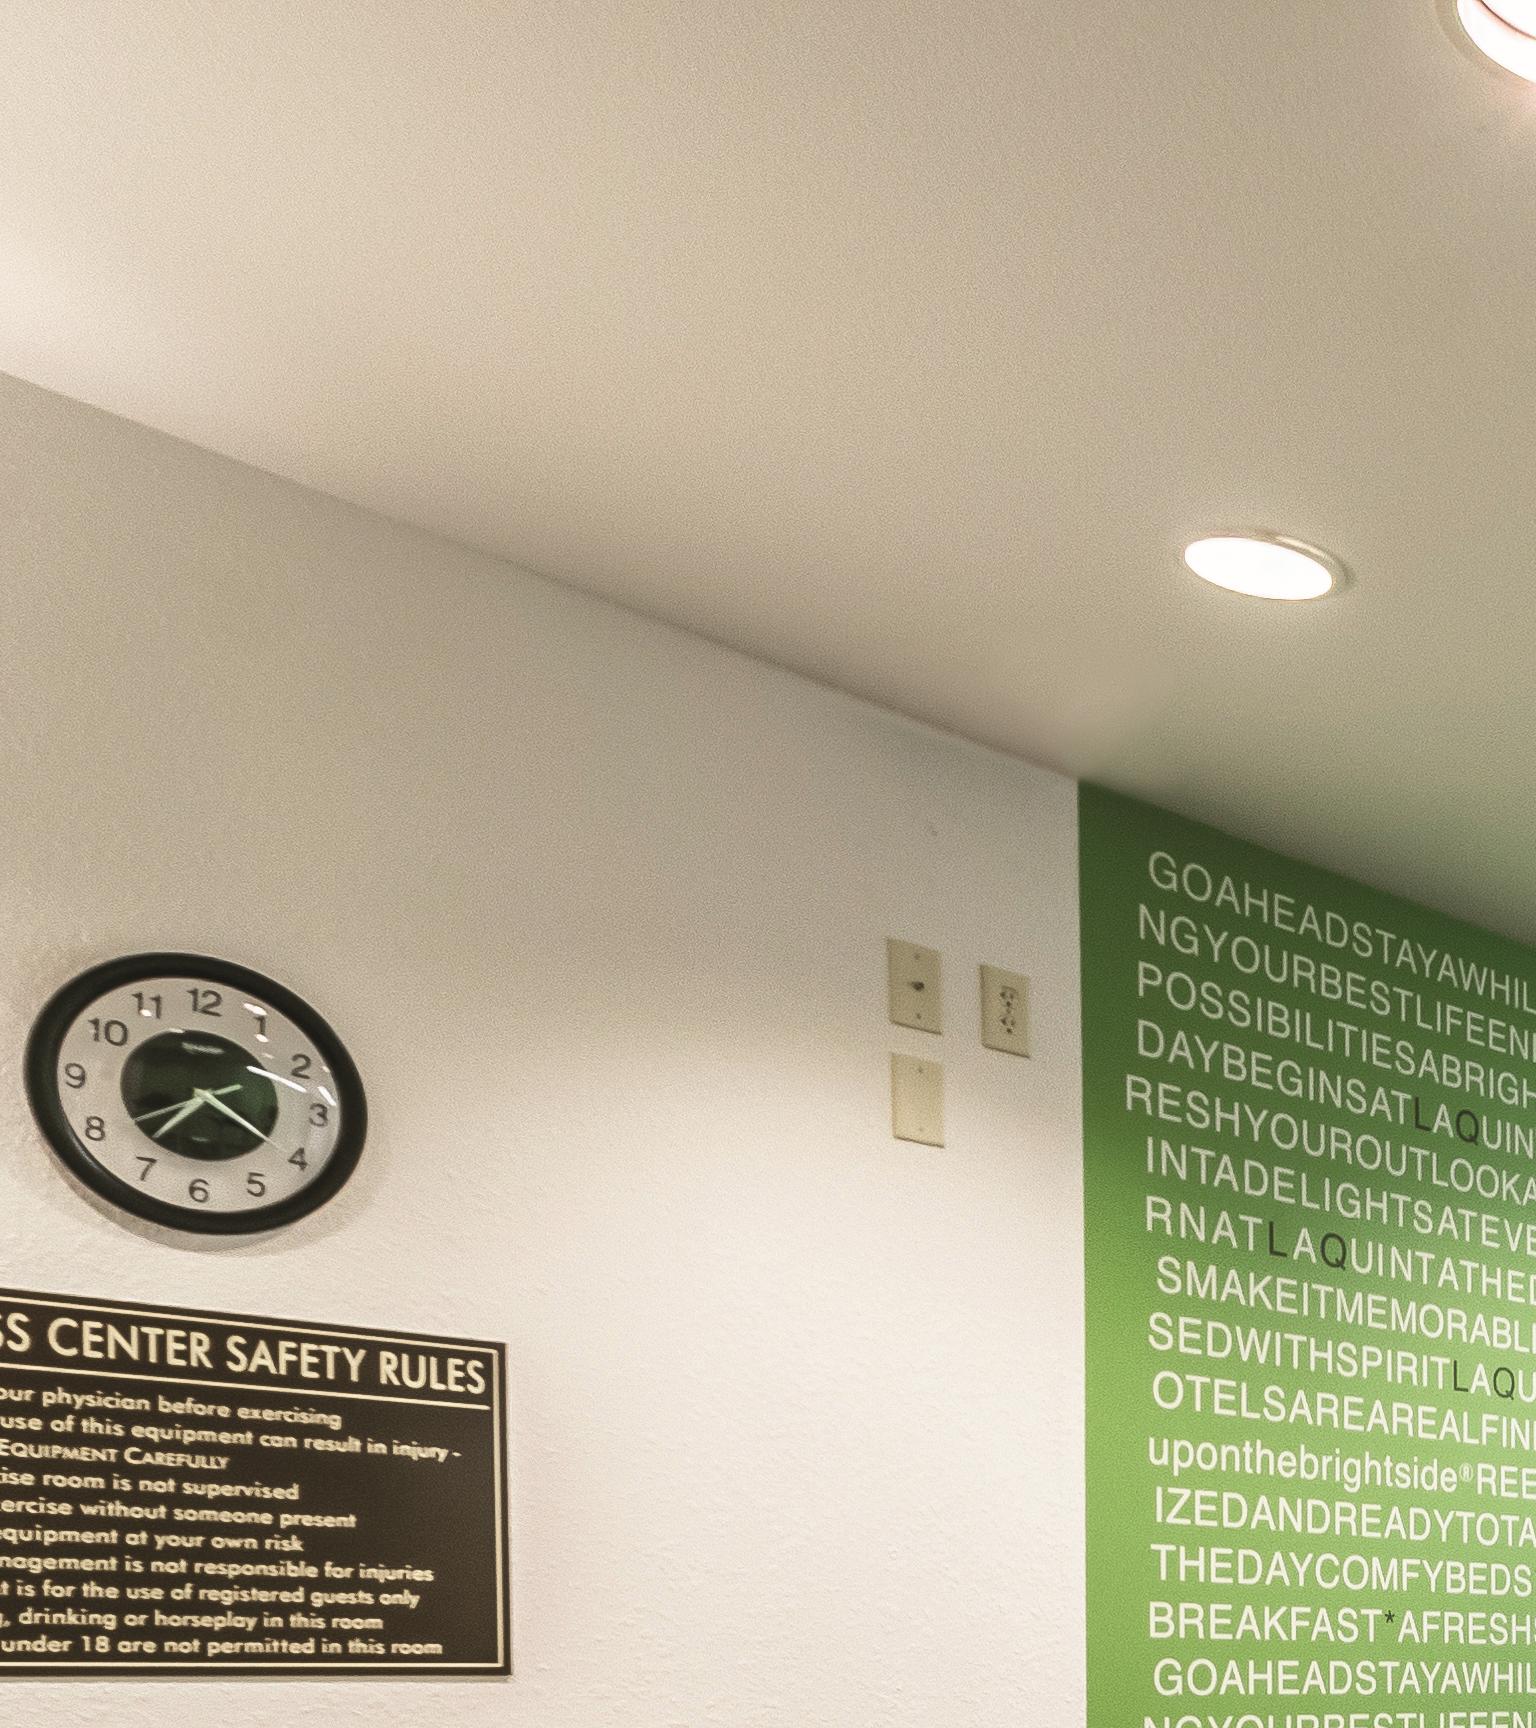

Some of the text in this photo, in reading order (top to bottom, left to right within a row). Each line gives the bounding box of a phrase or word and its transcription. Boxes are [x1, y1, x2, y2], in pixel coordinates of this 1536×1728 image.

[133, 993, 163, 1019] 11
[187, 988, 223, 1017] 12
[88, 1018, 129, 1046] 10
[255, 1015, 267, 1036] 1
[65, 1063, 86, 1088] 9
[292, 1054, 311, 1079] 2
[310, 1104, 328, 1127] 3
[86, 1116, 106, 1142] 8
[137, 1156, 157, 1181] 7
[289, 1147, 308, 1171] 4
[189, 1179, 209, 1203] 6
[247, 1173, 266, 1197] 5
[48, 1317, 213, 1369] CENTER
[226, 1335, 367, 1383] SAFETY
[380, 1350, 485, 1395] RULES
[43, 1387, 150, 1411] physician
[158, 1394, 230, 1418] before
[238, 1406, 342, 1430] exercising
[1, 1415, 43, 1431] use
[51, 1415, 75, 1432] of
[81, 1416, 124, 1437] this
[132, 1423, 253, 1445] equipment
[260, 1434, 297, 1448] can
[304, 1436, 361, 1453] result
[367, 1438, 387, 1455] in
[43, 1472, 105, 1489] room
[113, 1473, 132, 1491] is
[139, 1478, 175, 1493] not
[182, 1481, 299, 1500] supervised
[80, 1500, 167, 1519] without
[173, 1507, 273, 1525] someone
[280, 1513, 356, 1528] present
[0, 1524, 304, 1551] quipment at your own risk
[125, 1555, 144, 1573] is
[151, 1559, 188, 1574] not
[194, 1561, 319, 1579] responsible
[324, 1561, 355, 1578] for
[359, 1563, 434, 1583] injuries
[17, 1579, 36, 1597] is
[42, 1579, 76, 1597] for
[82, 1581, 120, 1598] the
[126, 1587, 164, 1599] use
[171, 1583, 194, 1600] of
[199, 1585, 305, 1606] registered
[310, 1591, 375, 1608] guests
[379, 1589, 420, 1609] only
[19, 1607, 117, 1630] drinking
[124, 1613, 149, 1627] or
[154, 1609, 258, 1632] horseplay
[264, 1611, 283, 1627] in
[290, 1612, 325, 1629] this
[332, 1618, 383, 1629] room
[1, 1634, 443, 1657] under 18 are not permitted in this room
